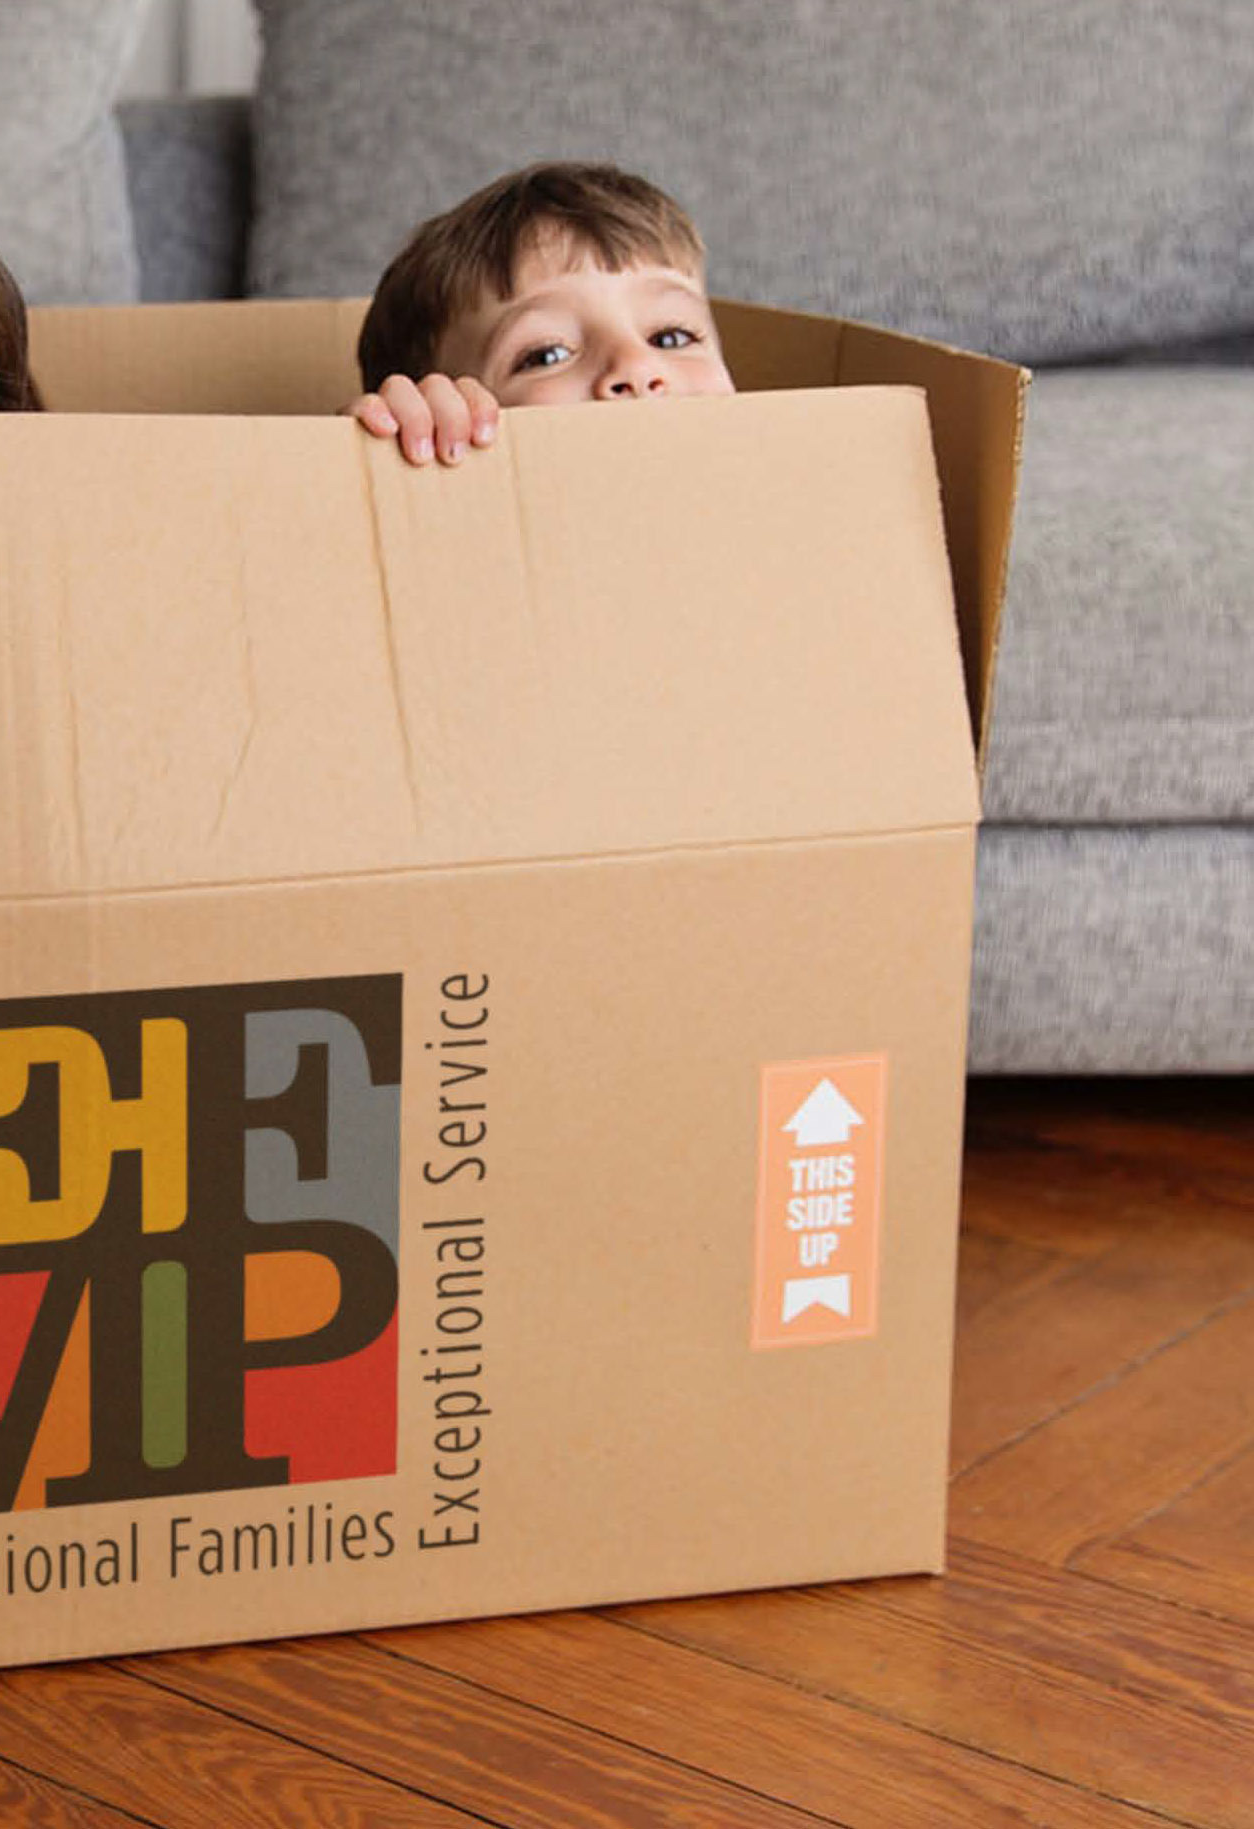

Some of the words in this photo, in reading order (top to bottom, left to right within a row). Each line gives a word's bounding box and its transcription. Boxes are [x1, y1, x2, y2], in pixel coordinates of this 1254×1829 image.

[422, 972, 490, 1184] Service
[788, 1154, 855, 1192] THIS
[785, 1191, 854, 1231] SIDE
[798, 1232, 839, 1267] UP
[418, 1217, 492, 1550] Exceptional
[169, 1502, 396, 1579] Families
